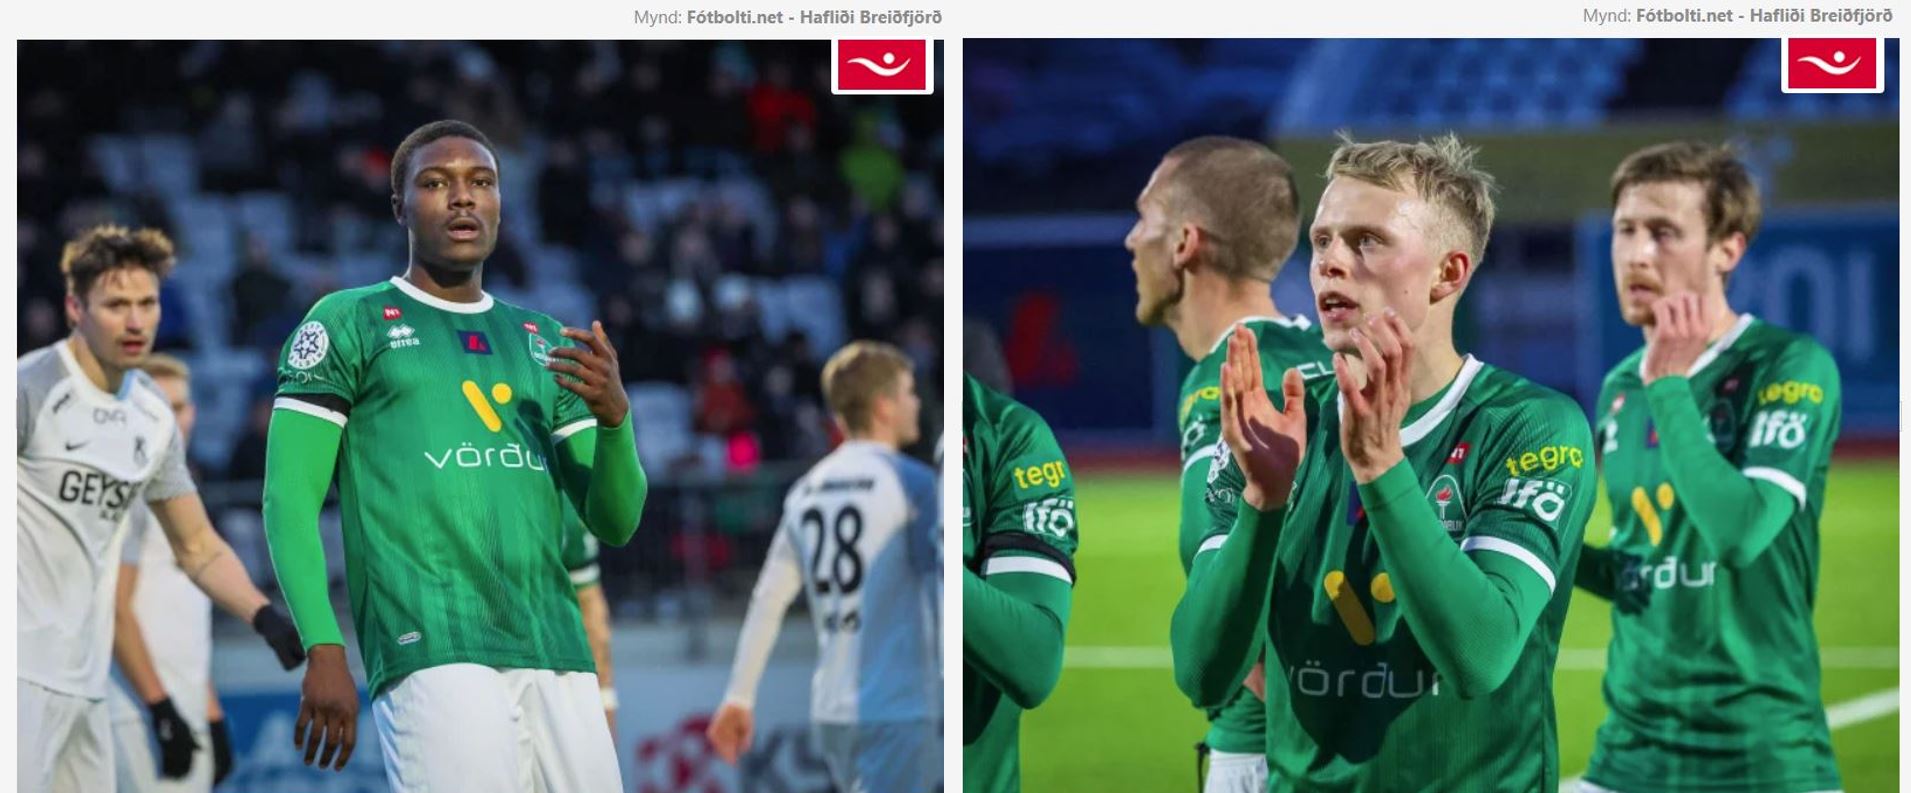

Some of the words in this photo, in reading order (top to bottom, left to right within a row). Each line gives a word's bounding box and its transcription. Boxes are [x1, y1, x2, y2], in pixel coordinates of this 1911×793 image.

[423, 441, 548, 471] vörðu
[1505, 444, 1584, 477] tegra
[1014, 460, 1066, 489] tegr
[801, 504, 863, 595] 28
